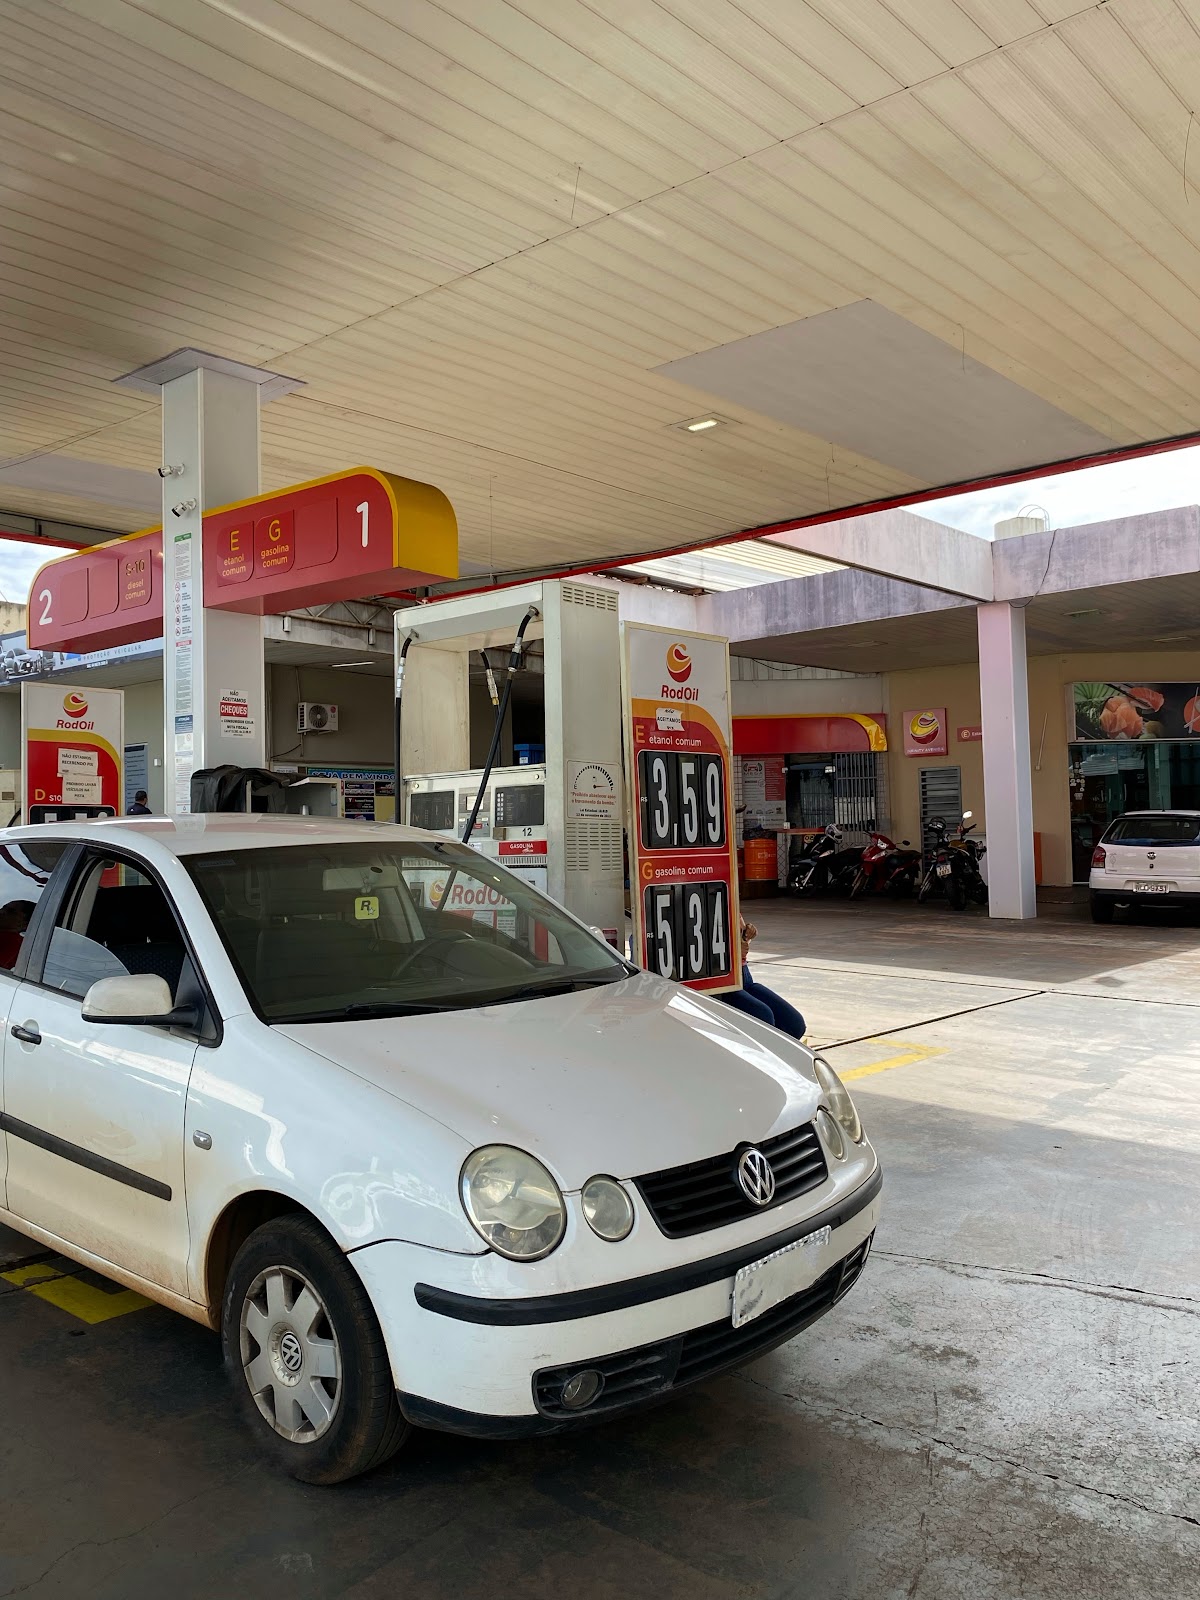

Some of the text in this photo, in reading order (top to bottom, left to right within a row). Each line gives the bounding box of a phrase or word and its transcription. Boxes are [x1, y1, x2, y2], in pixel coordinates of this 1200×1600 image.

[268, 519, 281, 542] G
[356, 501, 369, 548] 1
[230, 530, 239, 551] E
[260, 544, 290, 560] gasolina
[223, 553, 245, 566] etanol
[262, 555, 288, 568] comum
[125, 559, 145, 576] S-10
[222, 565, 246, 577] comum
[127, 579, 144, 590] diesel
[125, 589, 146, 600] comum
[39, 589, 53, 626] 2
[83, 650, 110, 662] PROTEÇÃO
[114, 645, 142, 657] VEICULAR
[222, 696, 247, 704] ACEITAMOS
[661, 685, 699, 701] RodOil
[220, 704, 248, 716] CHEQUES
[56, 719, 94, 730] RodOil
[657, 716, 681, 724] ACEITAMOS
[635, 724, 702, 747] E etanol comum
[342, 772, 363, 780] BEM
[34, 788, 62, 802] D S10
[652, 757, 721, 846] 3,59
[522, 827, 532, 836] 12
[642, 862, 714, 880] G gasolina comum
[361, 900, 370, 911] R
[656, 891, 726, 979] 5,34
